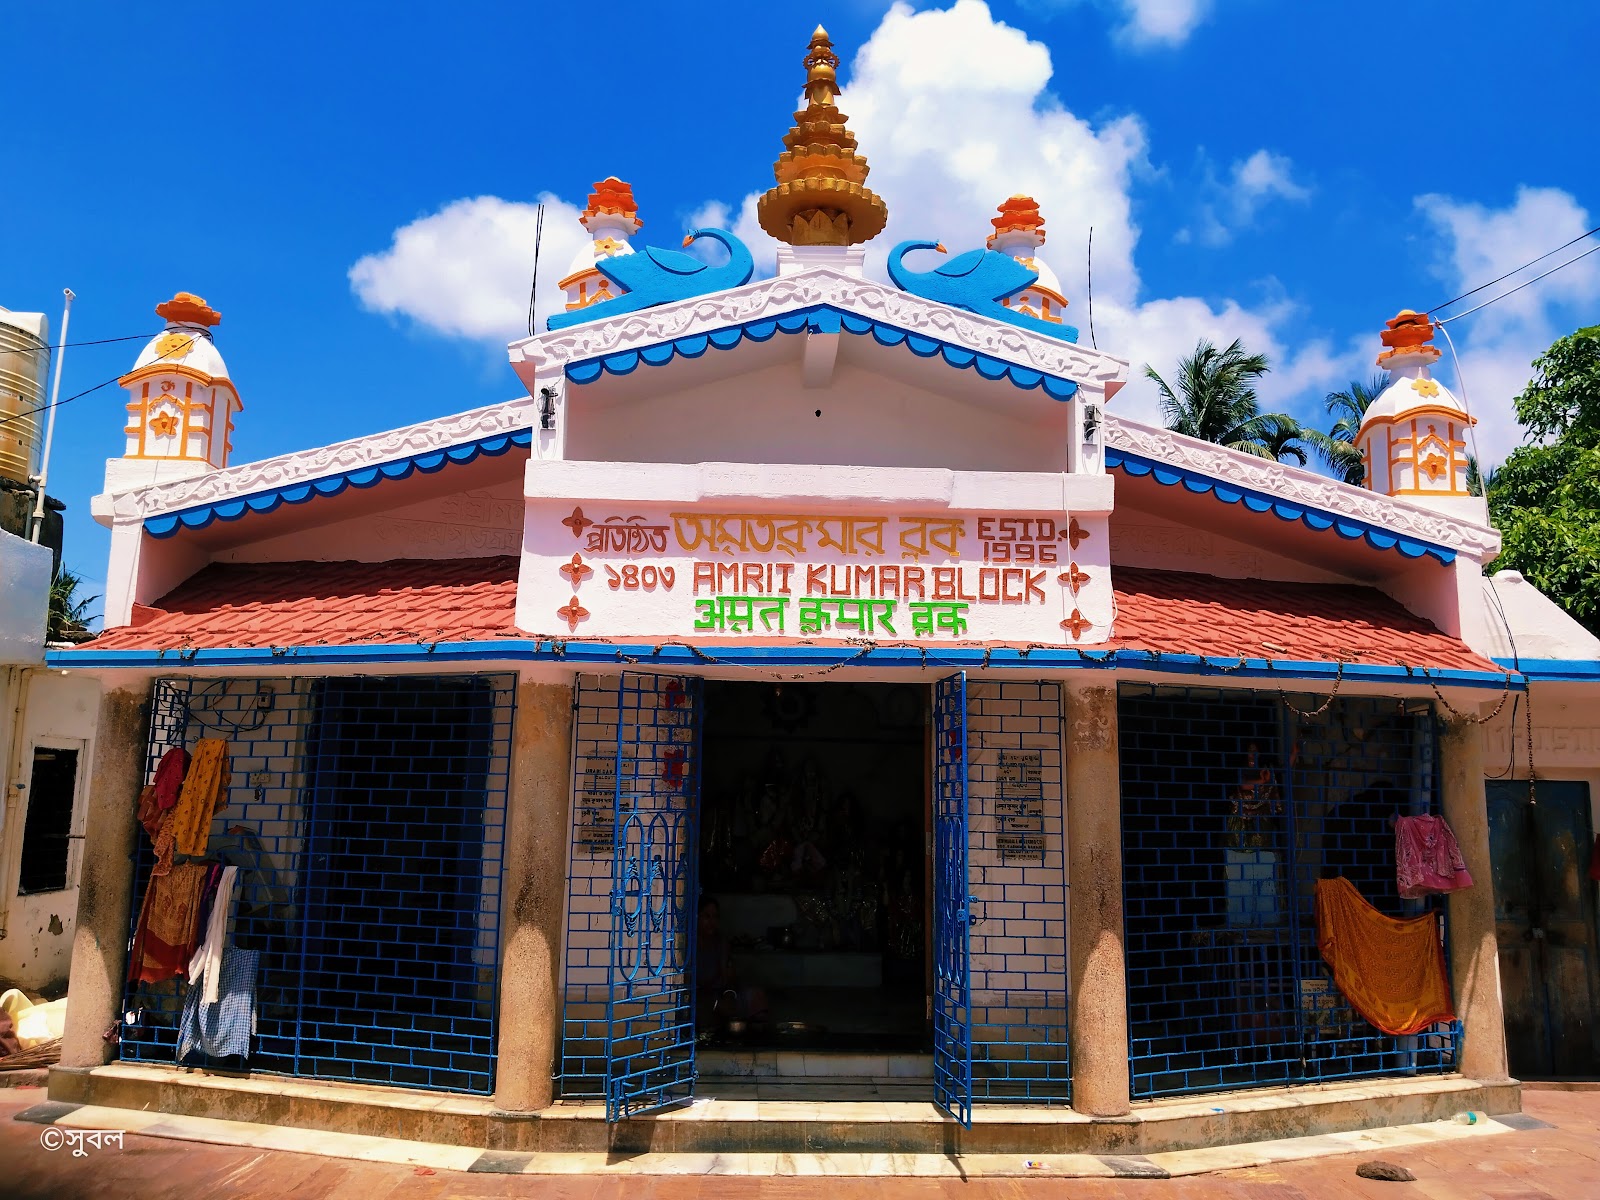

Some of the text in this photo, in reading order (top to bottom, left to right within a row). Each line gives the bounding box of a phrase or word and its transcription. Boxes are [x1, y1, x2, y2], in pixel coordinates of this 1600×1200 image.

[983, 541, 1058, 563] 1996
[604, 564, 675, 589] ১৪০৩
[693, 561, 1047, 602] AMRIT KUMAR BLOCK
[694, 596, 790, 633] अमृत
